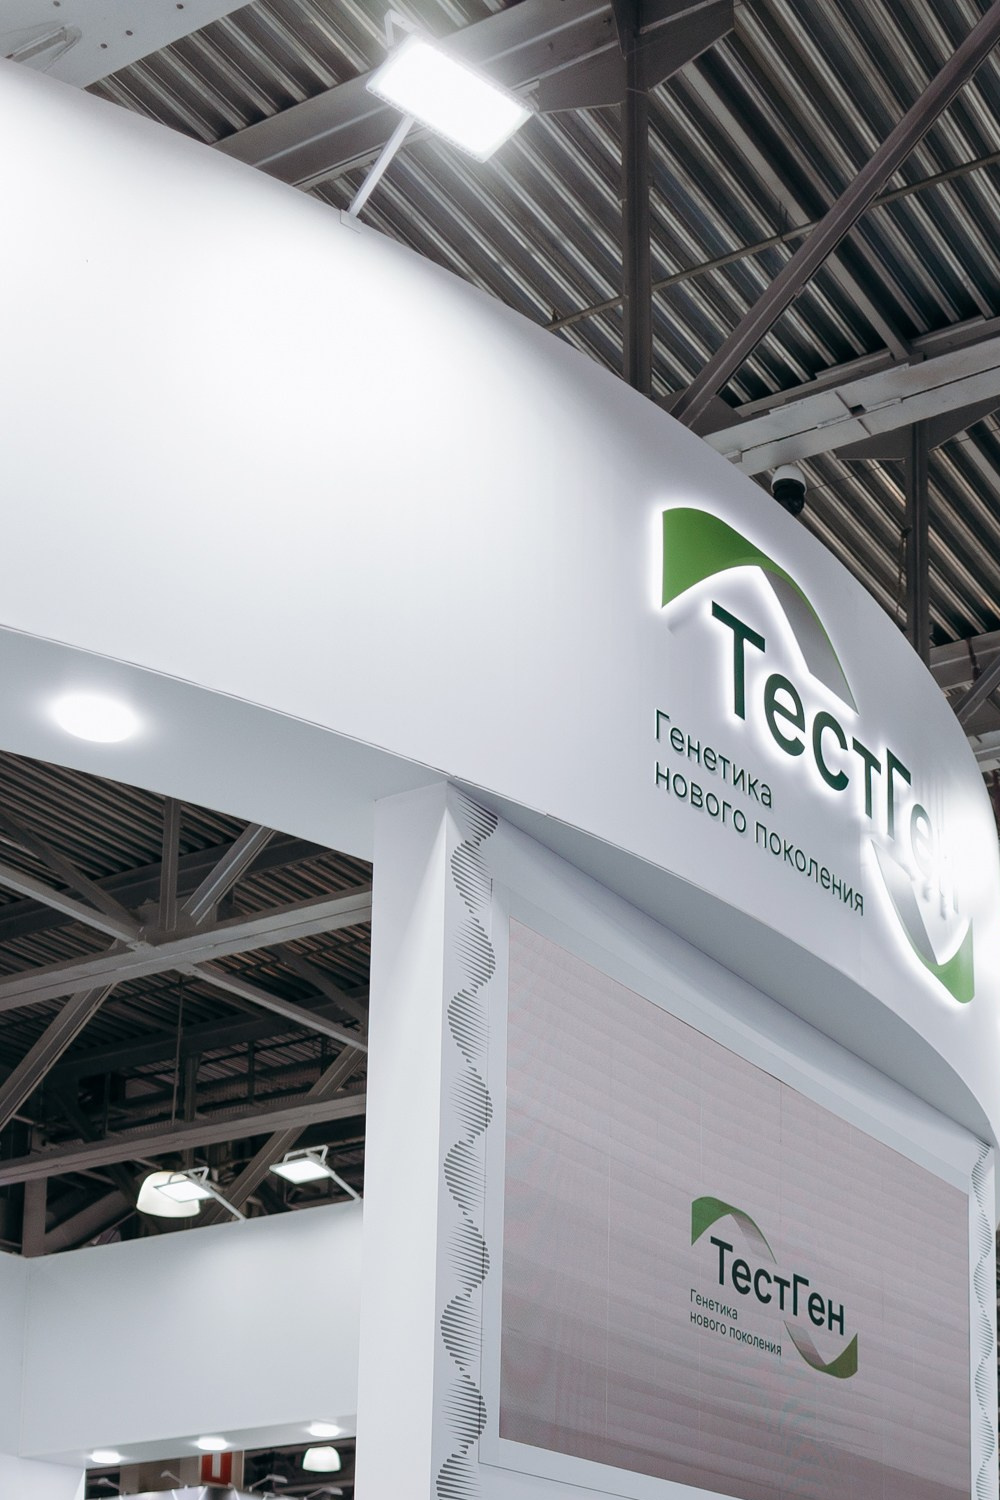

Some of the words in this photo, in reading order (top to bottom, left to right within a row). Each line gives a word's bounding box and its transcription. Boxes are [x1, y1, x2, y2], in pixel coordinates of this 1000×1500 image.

[655, 708, 772, 809] Генетика
[711, 600, 959, 916] ТестГе
[655, 761, 747, 833] нового
[755, 821, 864, 916] поколения
[690, 1288, 738, 1320] Генетика
[690, 1311, 727, 1335] нового
[729, 1326, 782, 1356] поколения
[710, 1235, 845, 1336] ТестГен
